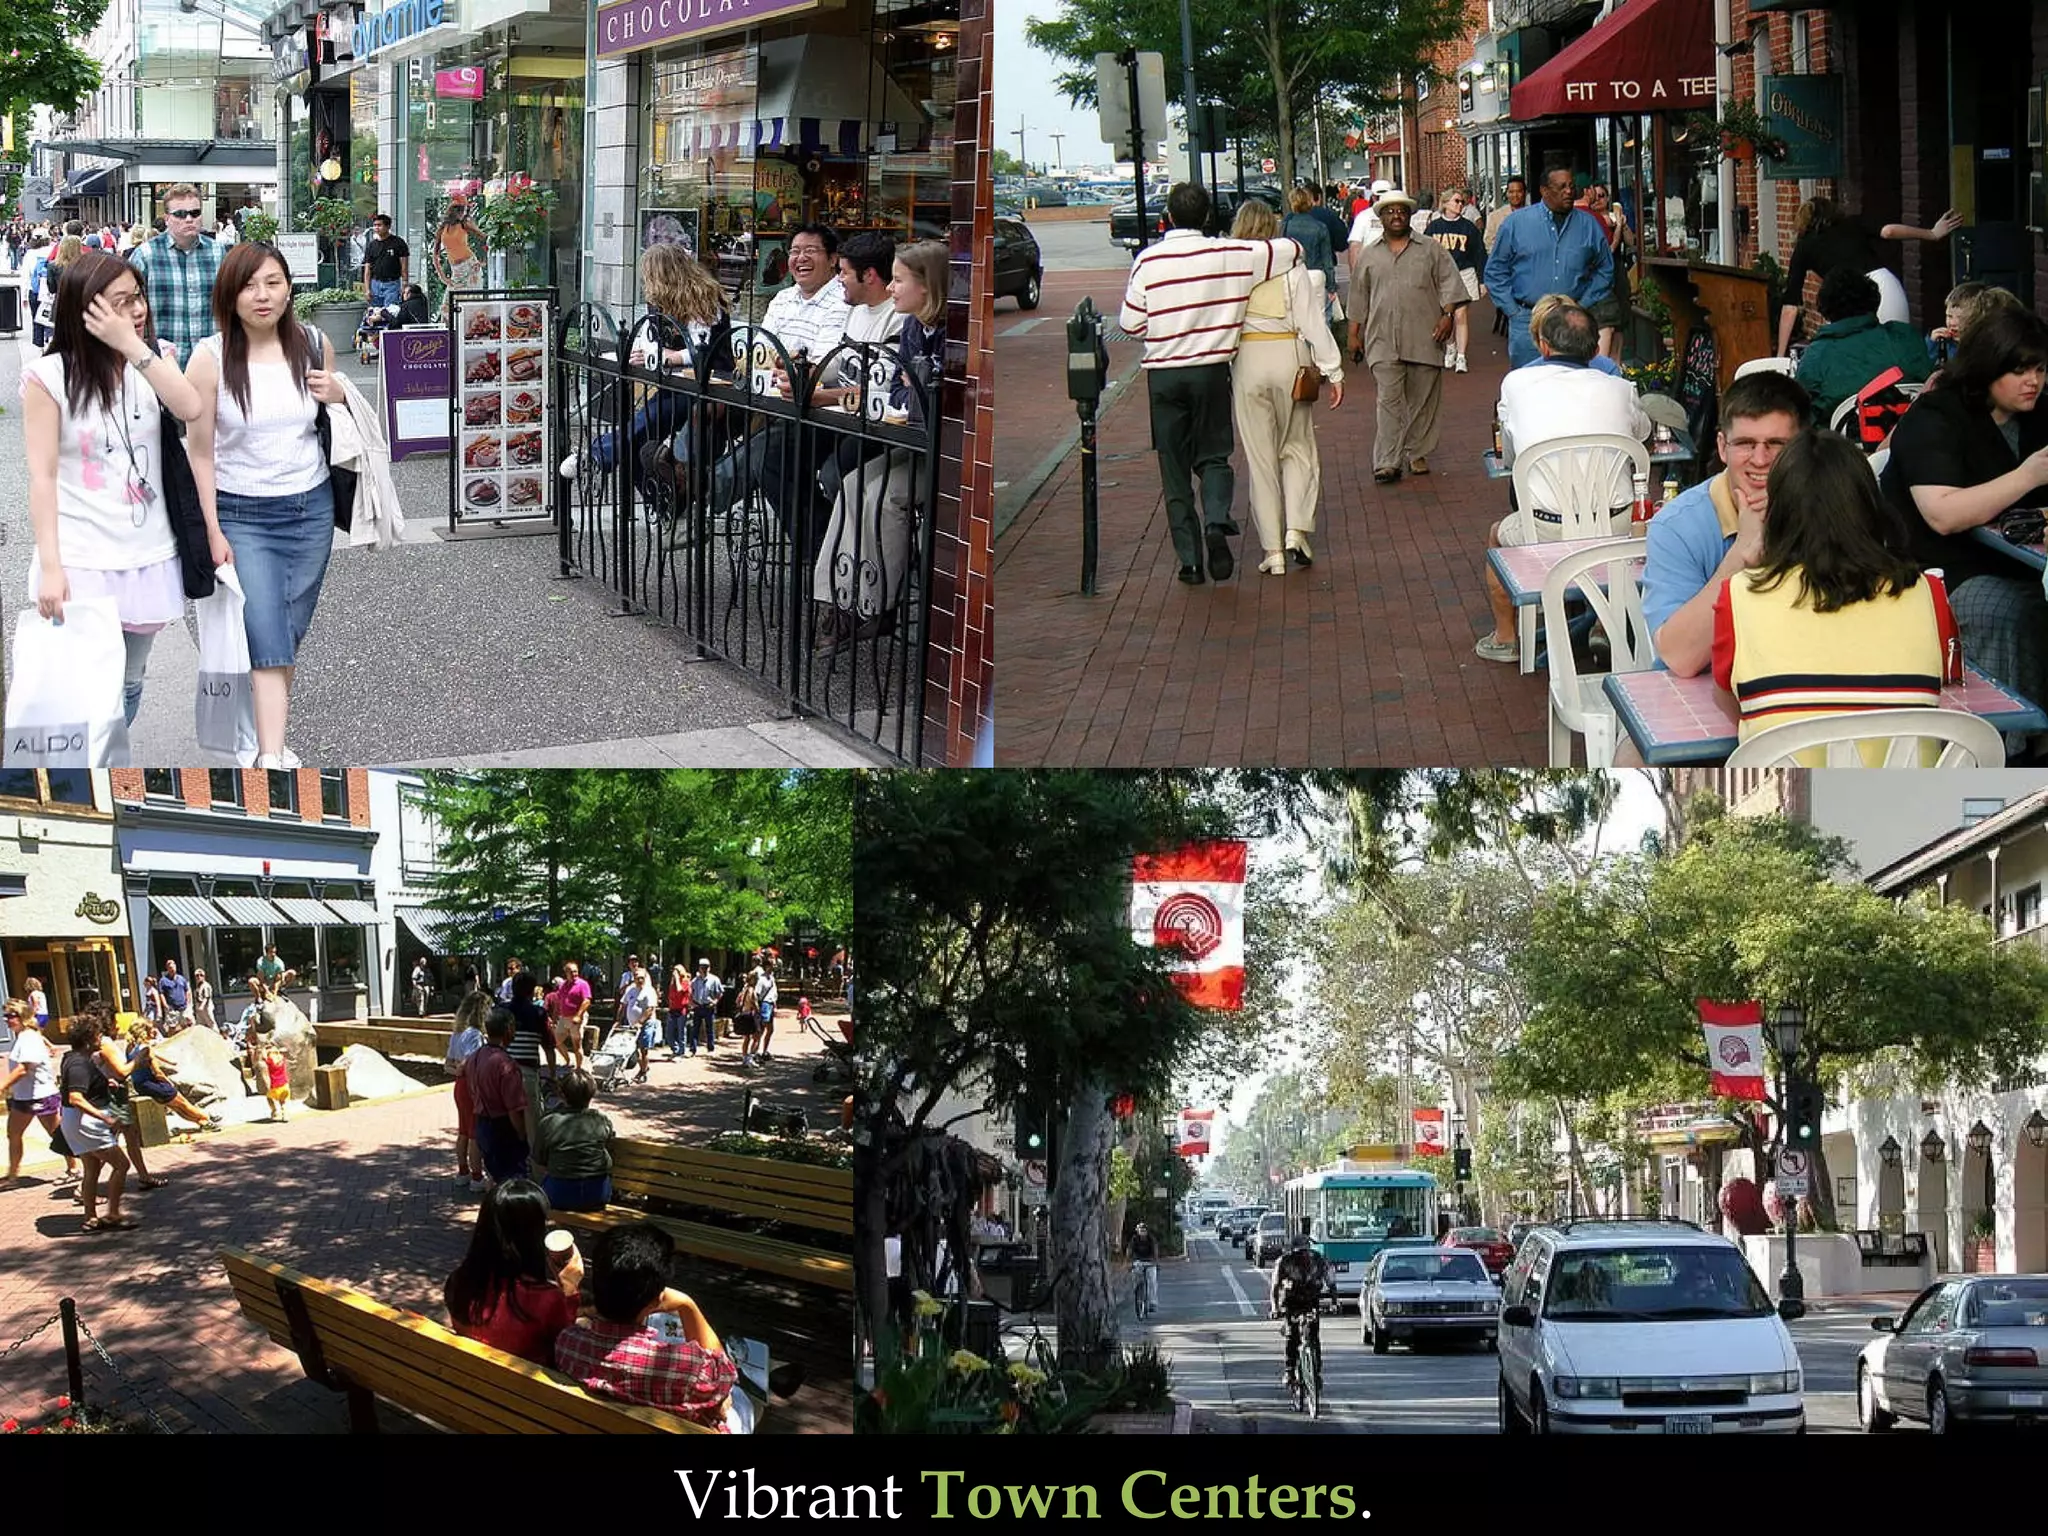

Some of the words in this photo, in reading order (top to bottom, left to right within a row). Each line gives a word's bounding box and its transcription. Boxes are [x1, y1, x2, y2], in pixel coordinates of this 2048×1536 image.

[606, 0, 751, 43] CHOCOLA
[1566, 82, 1598, 101] FIT
[1610, 80, 1641, 99] TO
[1651, 79, 1667, 98] A
[1678, 76, 1717, 97] TEE
[13, 733, 84, 755] ALDO
